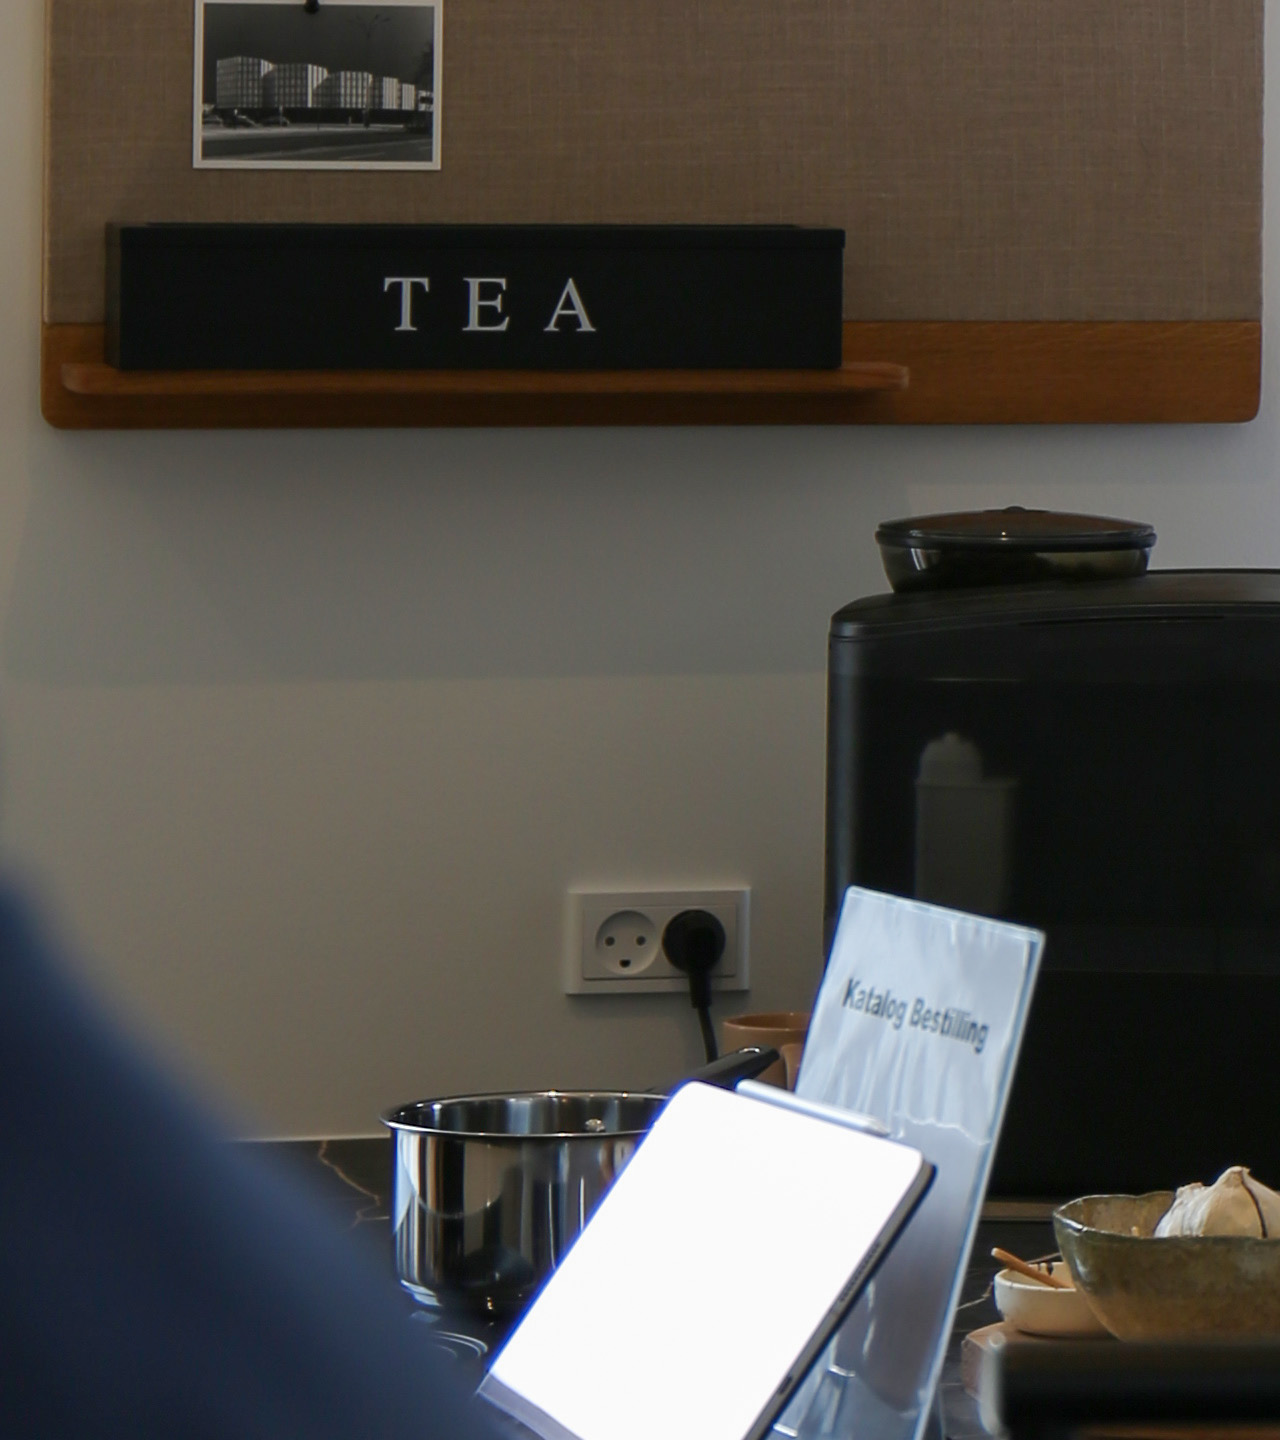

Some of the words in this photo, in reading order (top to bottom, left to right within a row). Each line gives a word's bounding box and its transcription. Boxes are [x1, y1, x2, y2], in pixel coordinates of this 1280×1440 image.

[383, 277, 597, 332] TEA
[842, 977, 907, 1030] Katalog
[909, 997, 990, 1055] Bestilling
